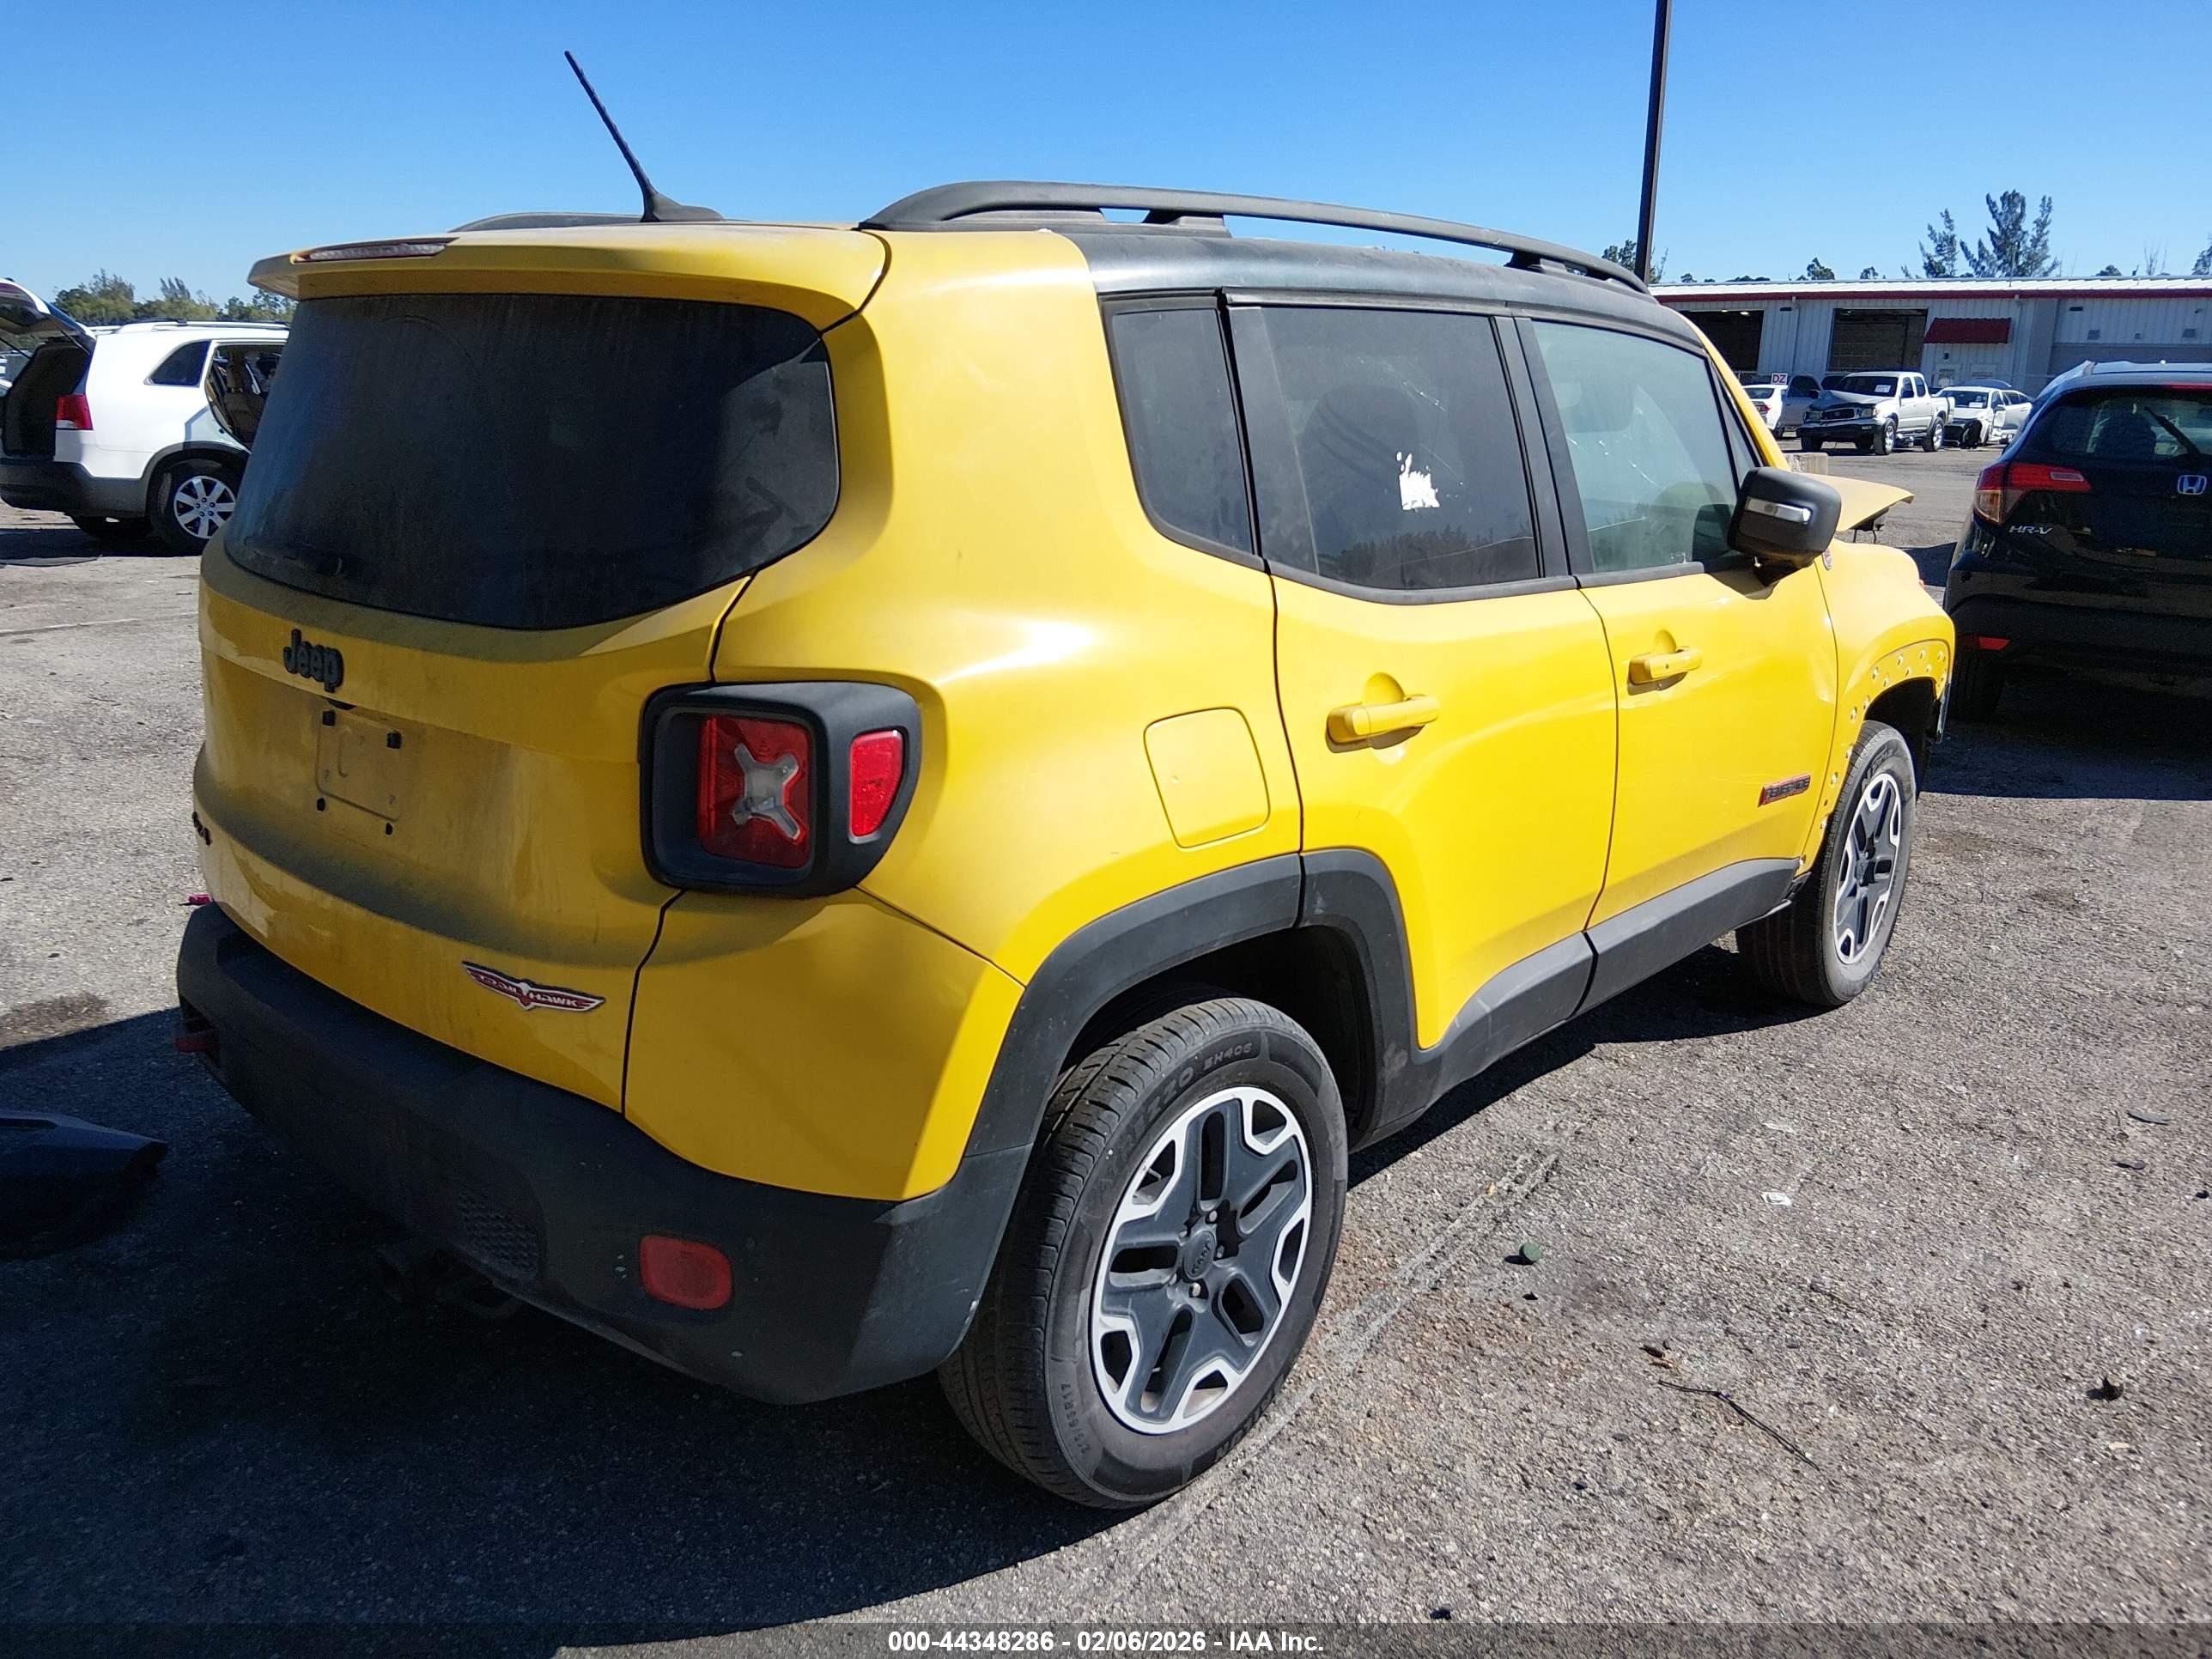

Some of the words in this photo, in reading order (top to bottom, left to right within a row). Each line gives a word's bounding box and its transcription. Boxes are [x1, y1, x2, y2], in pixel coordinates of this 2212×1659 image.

[1772, 374, 1787, 384] DZ
[2008, 525, 2053, 535] HR-V
[283, 629, 344, 694] Jeep
[529, 992, 578, 1007] HAWK
